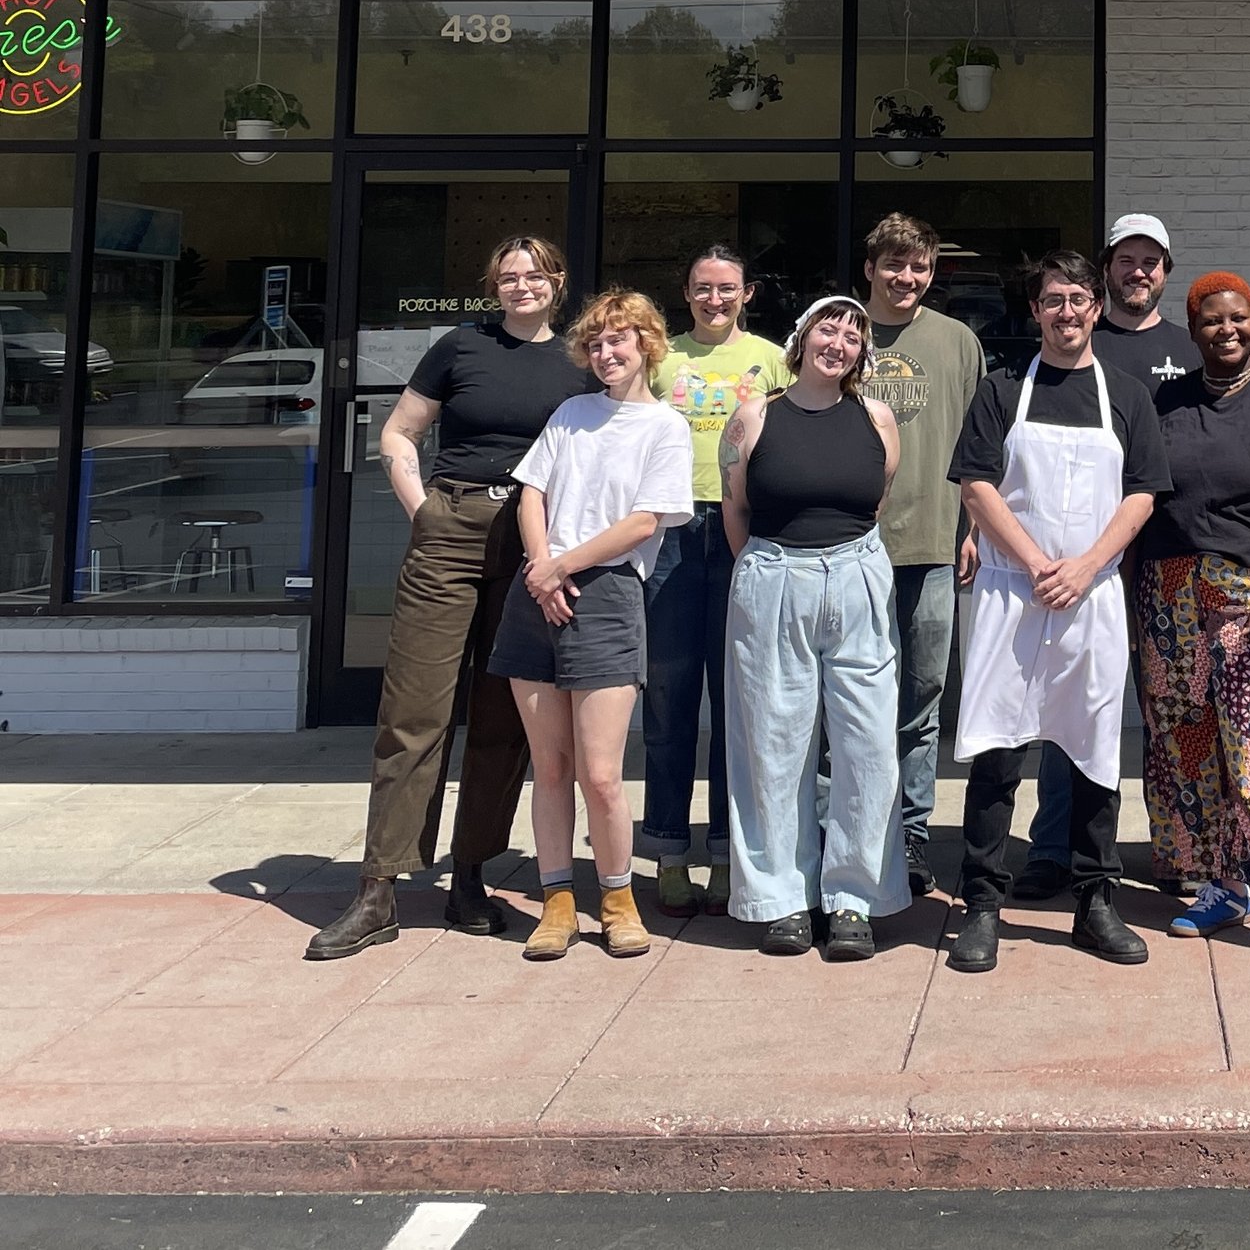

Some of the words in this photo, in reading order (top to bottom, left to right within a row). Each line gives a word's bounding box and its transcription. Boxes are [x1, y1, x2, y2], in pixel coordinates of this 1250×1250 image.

[441, 14, 512, 43] 438
[398, 298, 459, 312] POTCHKE
[464, 297, 502, 312] BAGE
